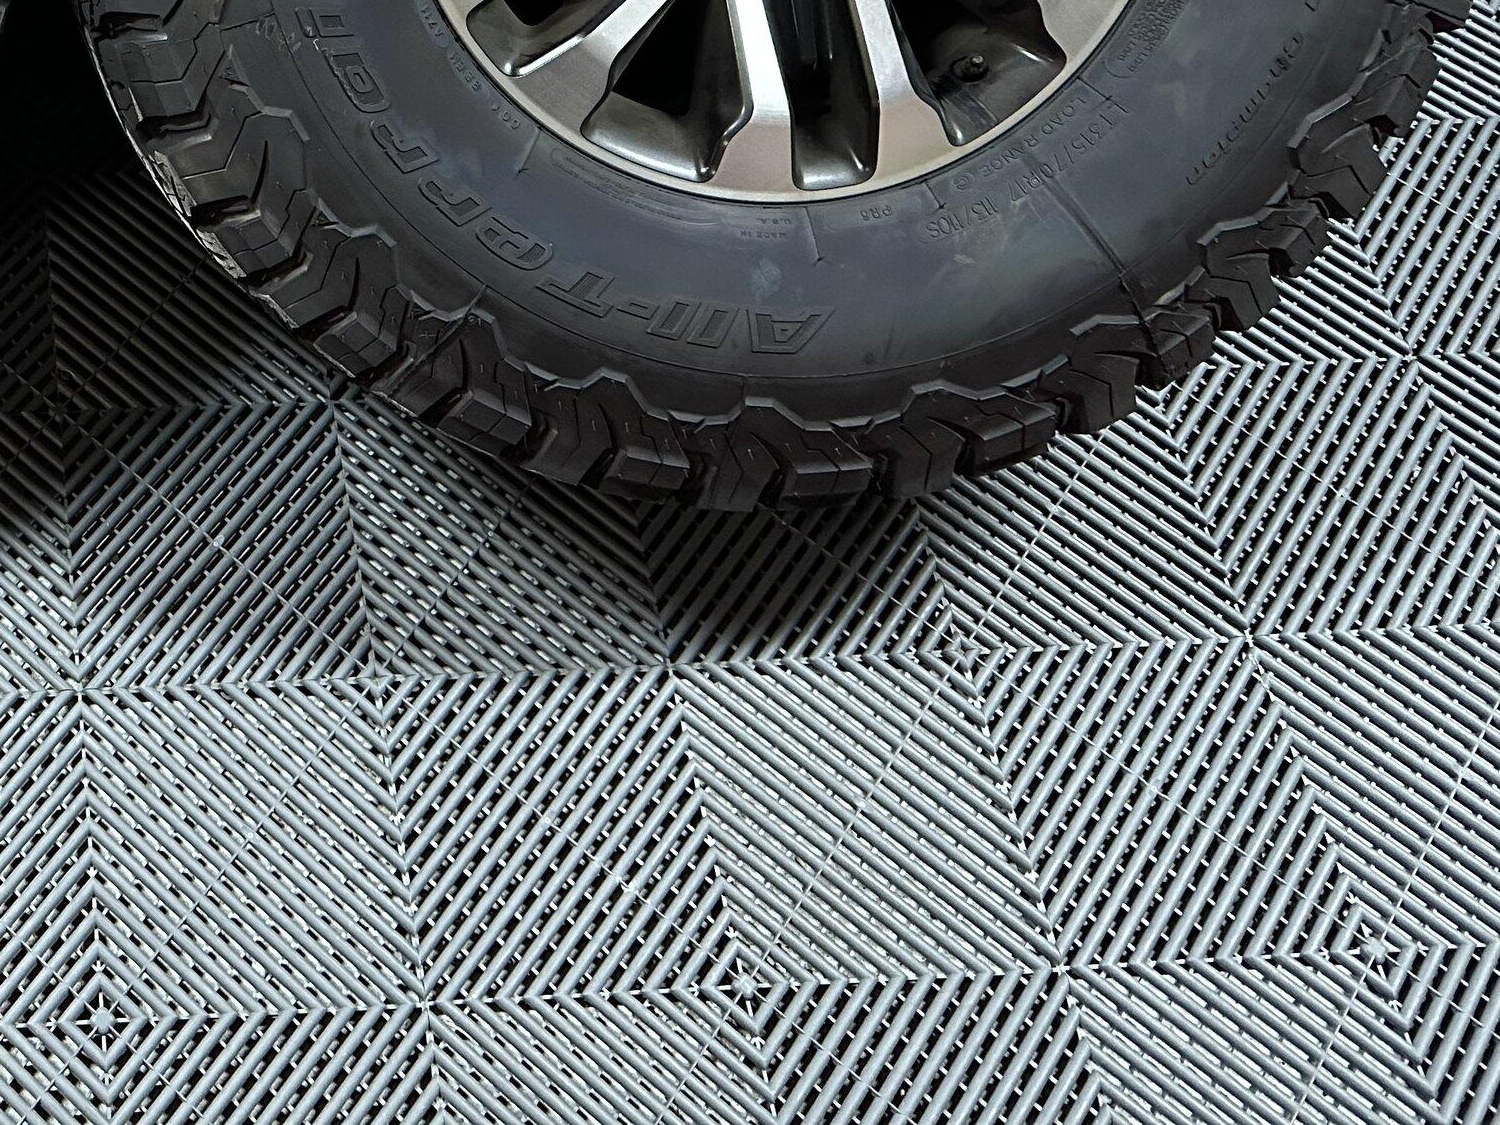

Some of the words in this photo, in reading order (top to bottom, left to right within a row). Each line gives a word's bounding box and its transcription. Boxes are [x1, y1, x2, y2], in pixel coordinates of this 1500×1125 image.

[1039, 94, 1086, 137] LOAD
[1186, 33, 1304, 185] Champion
[978, 133, 1041, 179] RANGE
[1003, 99, 1128, 203] LT315/70R17
[756, 230, 786, 239] MADE
